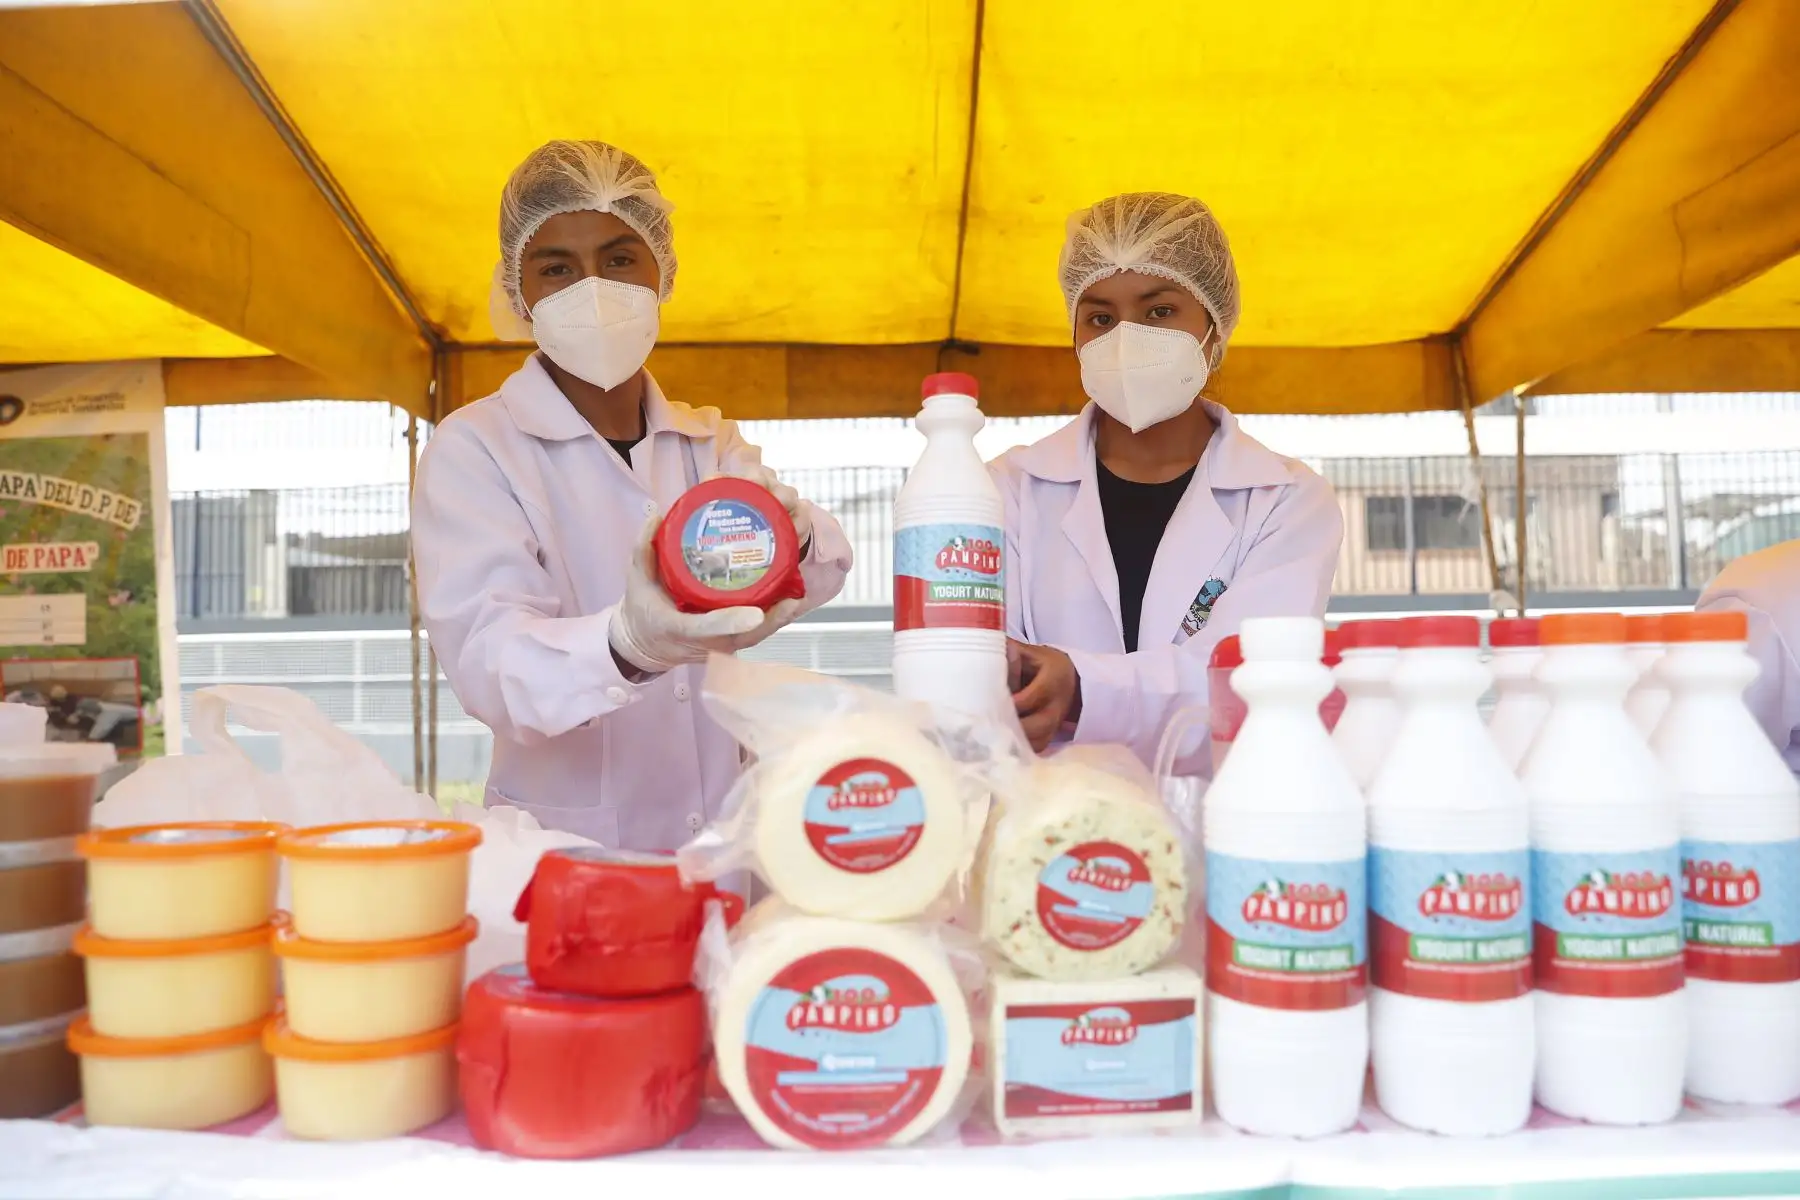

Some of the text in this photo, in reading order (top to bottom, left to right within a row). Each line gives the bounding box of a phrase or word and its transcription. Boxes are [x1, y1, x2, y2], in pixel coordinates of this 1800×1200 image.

[43, 480, 74, 507] DEL
[114, 499, 138, 525] DE
[6, 549, 28, 570] DE
[933, 585, 971, 599] YOGURT
[1698, 922, 1767, 945] NATURAL
